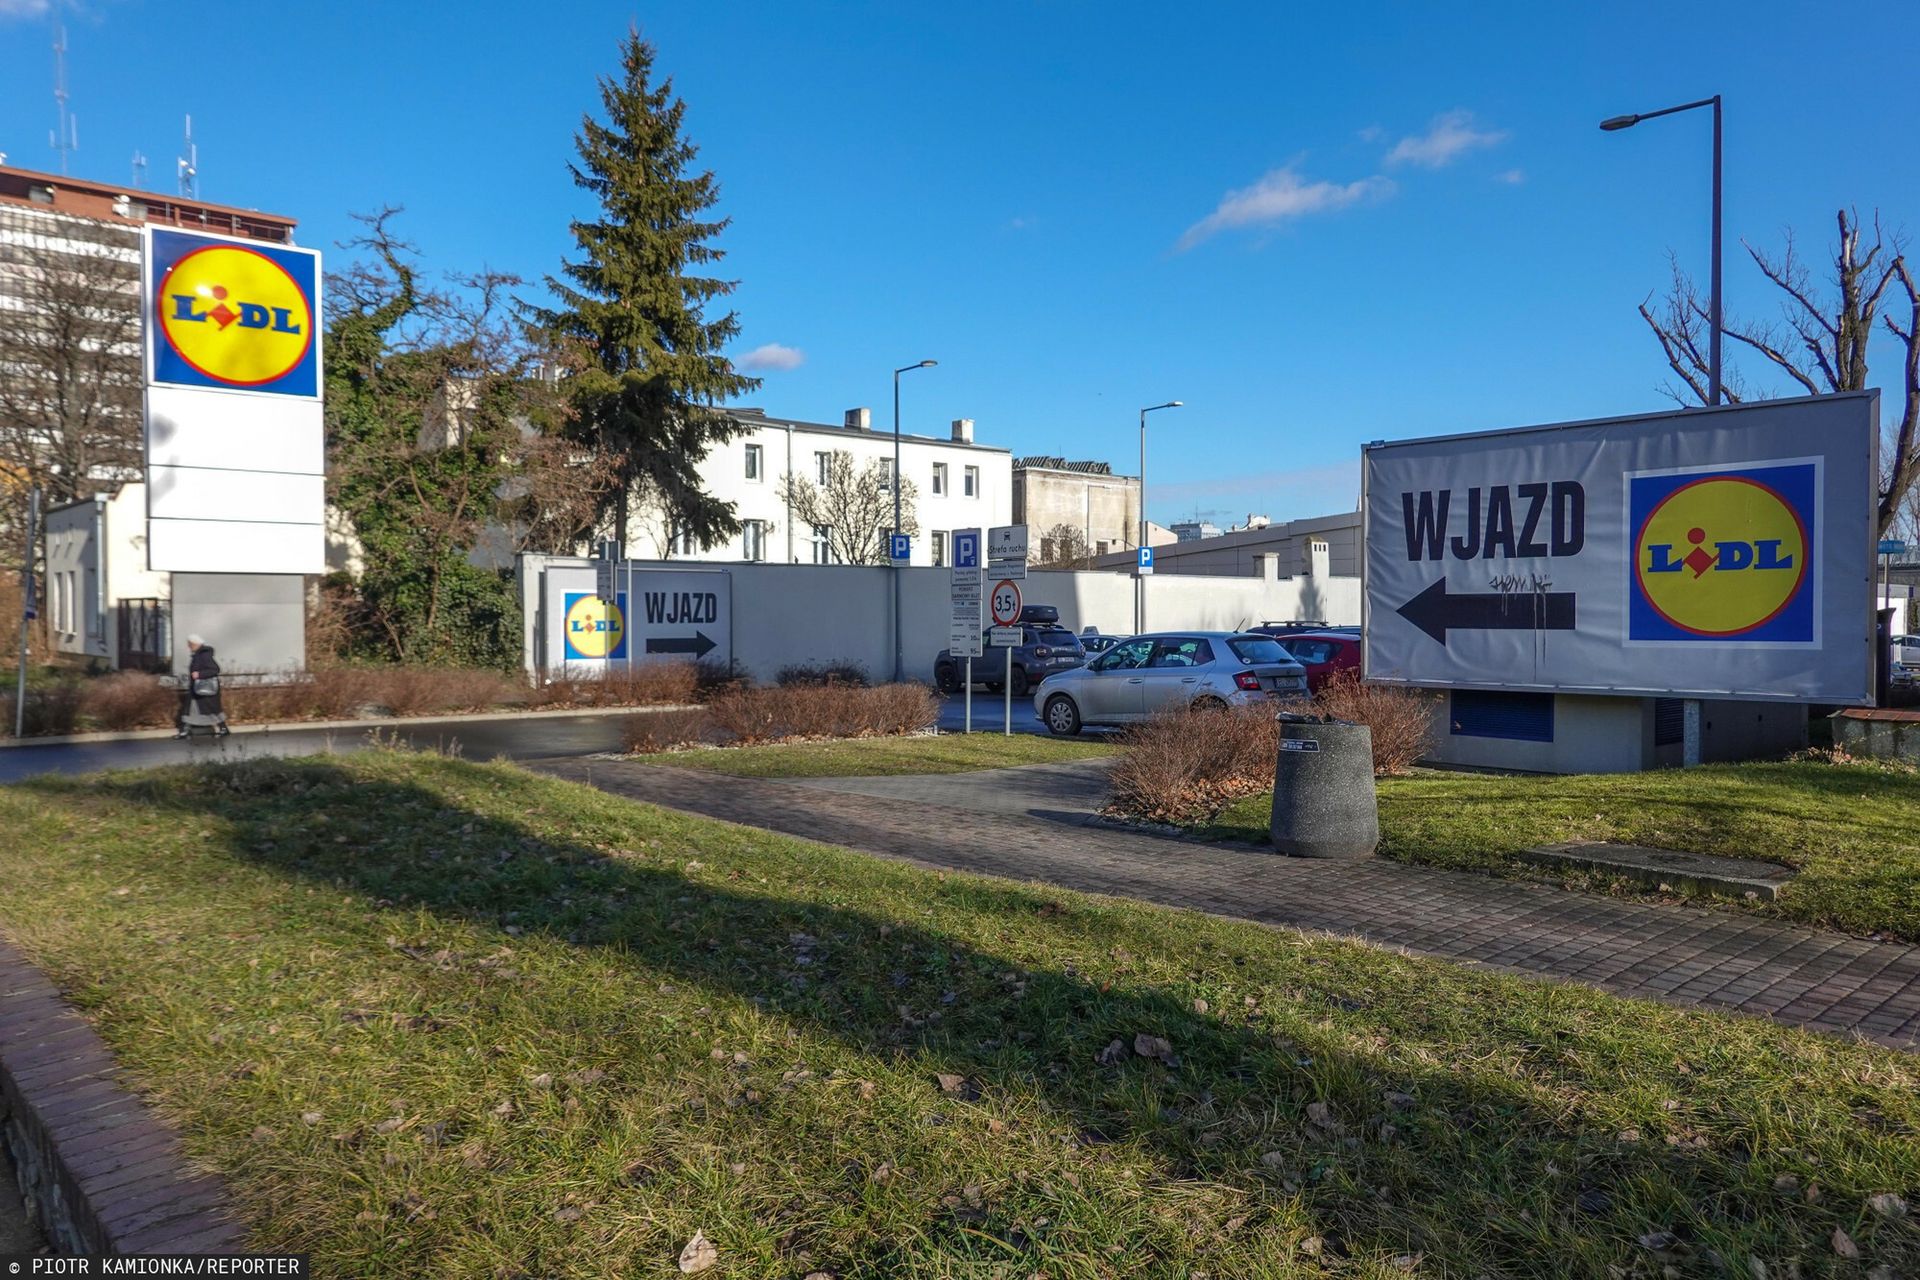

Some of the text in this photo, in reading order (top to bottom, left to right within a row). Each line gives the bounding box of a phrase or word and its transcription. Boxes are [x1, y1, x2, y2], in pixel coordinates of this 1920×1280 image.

[1401, 480, 1586, 562] WJAZD
[895, 537, 907, 557] P
[960, 538, 973, 564] P
[989, 543, 1026, 555] Strefa ruchu
[1141, 548, 1151, 565] P
[645, 592, 717, 624] WJAZD
